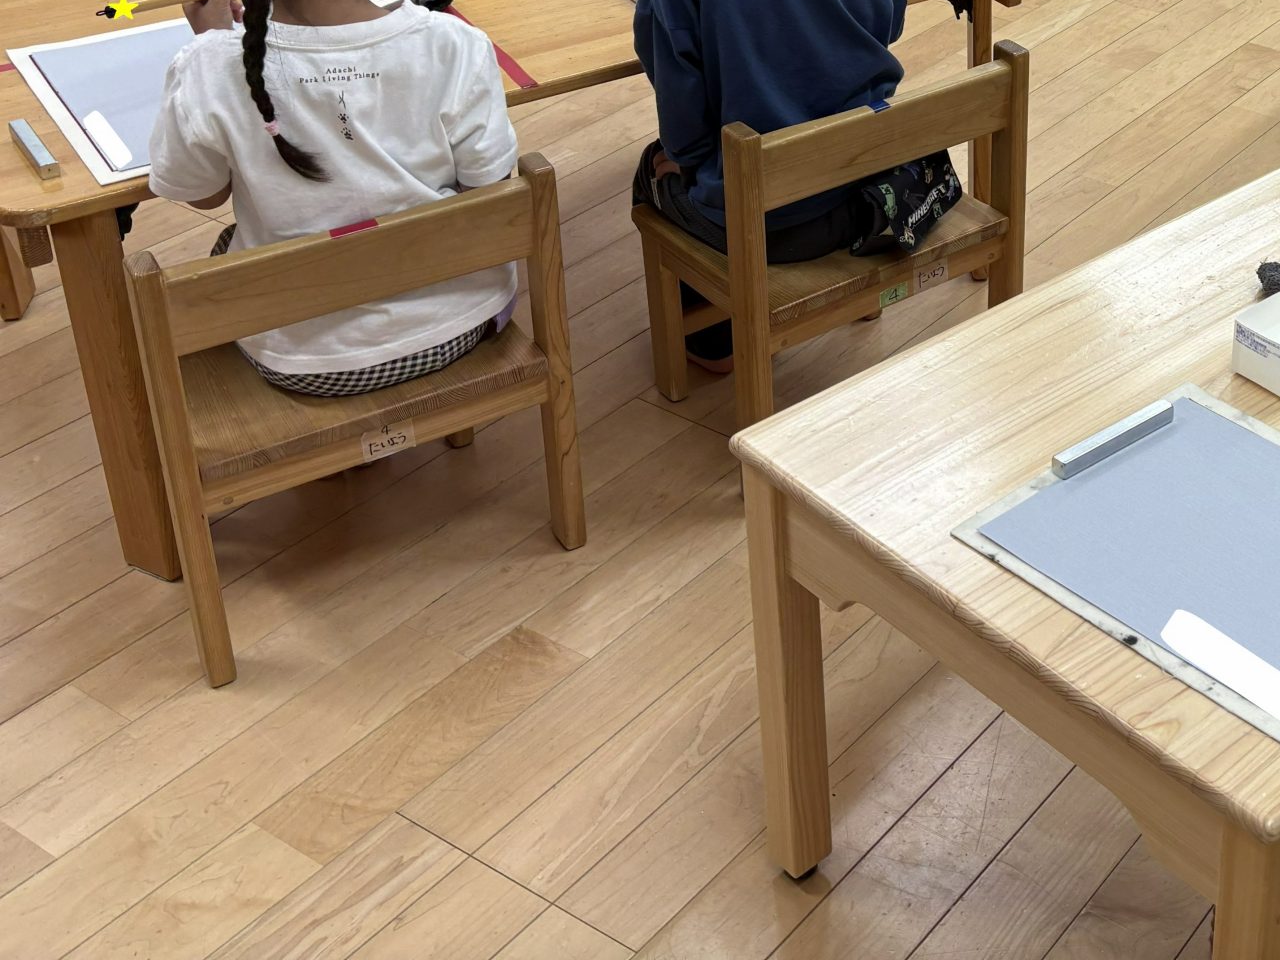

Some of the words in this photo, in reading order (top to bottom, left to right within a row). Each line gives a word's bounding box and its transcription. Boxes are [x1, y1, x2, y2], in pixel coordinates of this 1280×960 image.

[326, 66, 357, 74] Adachi
[299, 76, 319, 84] Park
[354, 72, 380, 80] Things
[908, 183, 947, 228] MINECRAFT
[918, 263, 945, 288] たいよう
[888, 288, 900, 302] 4
[380, 425, 392, 435] 4
[368, 432, 407, 456] たいよう
